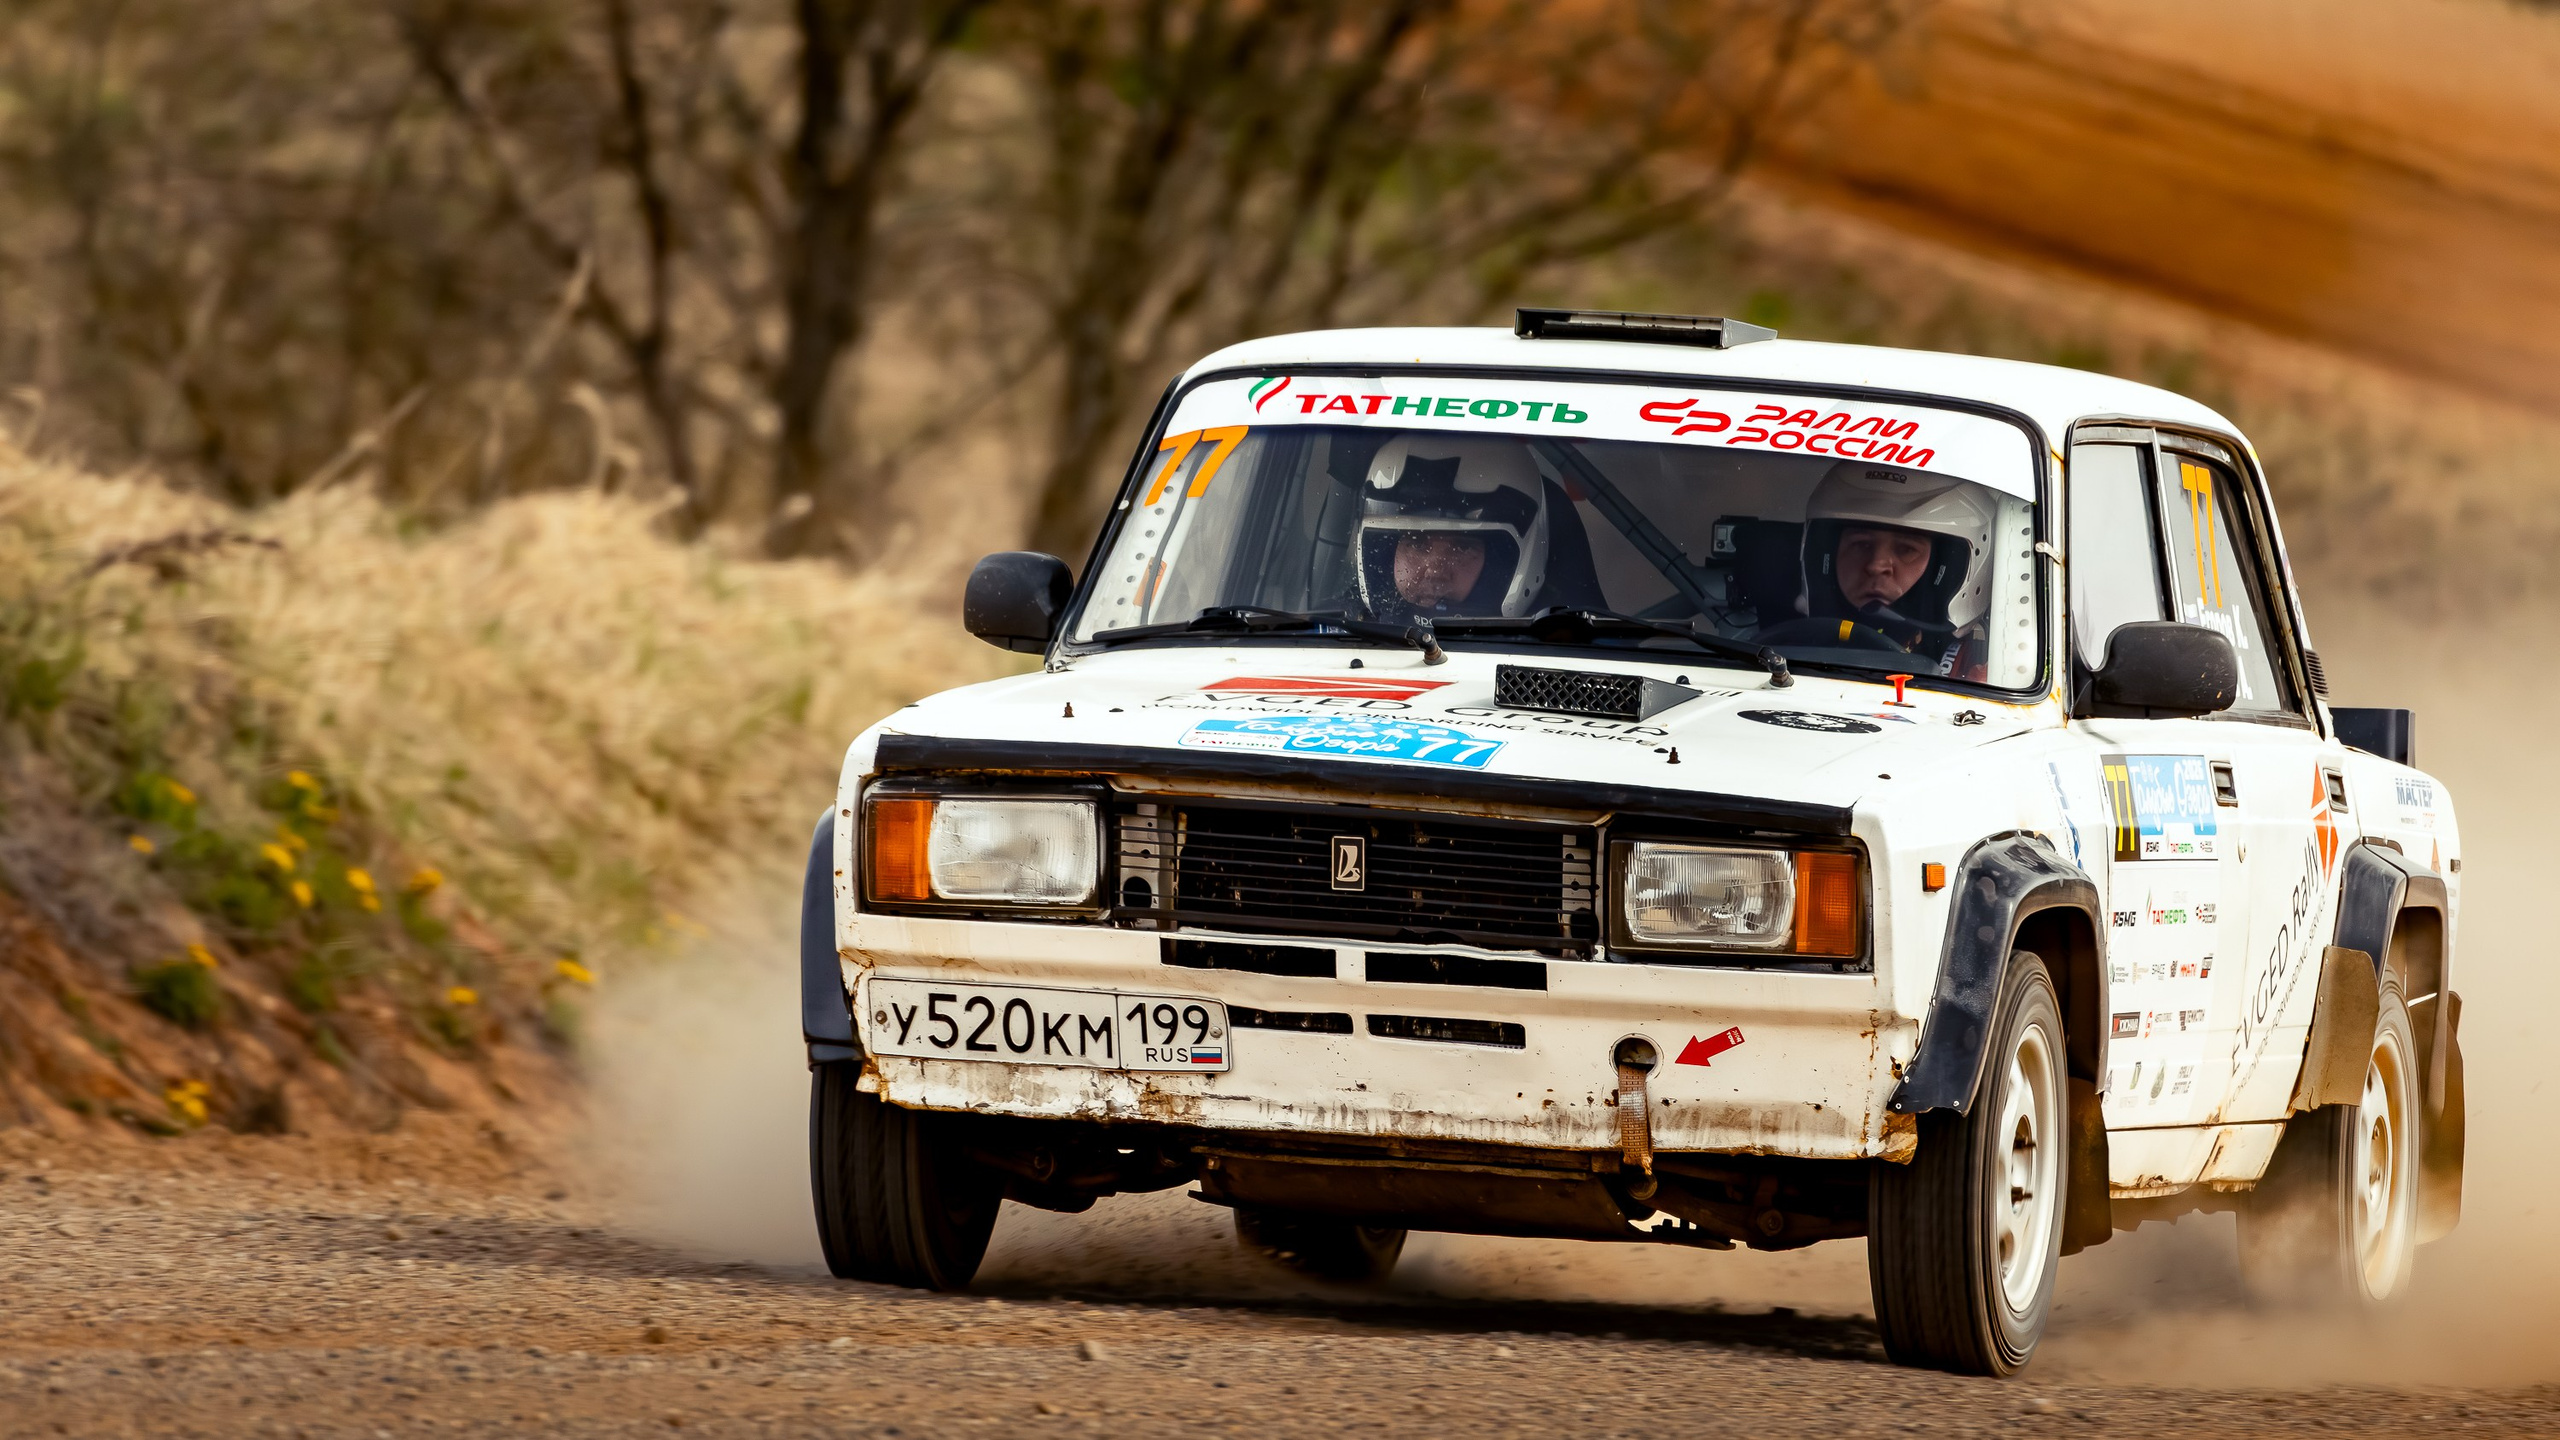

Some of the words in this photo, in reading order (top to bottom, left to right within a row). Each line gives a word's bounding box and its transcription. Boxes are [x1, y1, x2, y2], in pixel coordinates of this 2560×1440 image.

[1295, 394, 1589, 424] ТАТНЕФТЬ
[1744, 404, 1919, 440] РАЛЛИ
[1144, 425, 1249, 507] 77
[1726, 426, 1935, 468] РОССИИ
[2181, 462, 2222, 609] 77
[1413, 736, 1500, 763] 77
[2103, 764, 2135, 852] 77
[2292, 831, 2320, 941] Rally
[1125, 1002, 1210, 1045] 199
[1146, 1047, 1189, 1063] RUS
